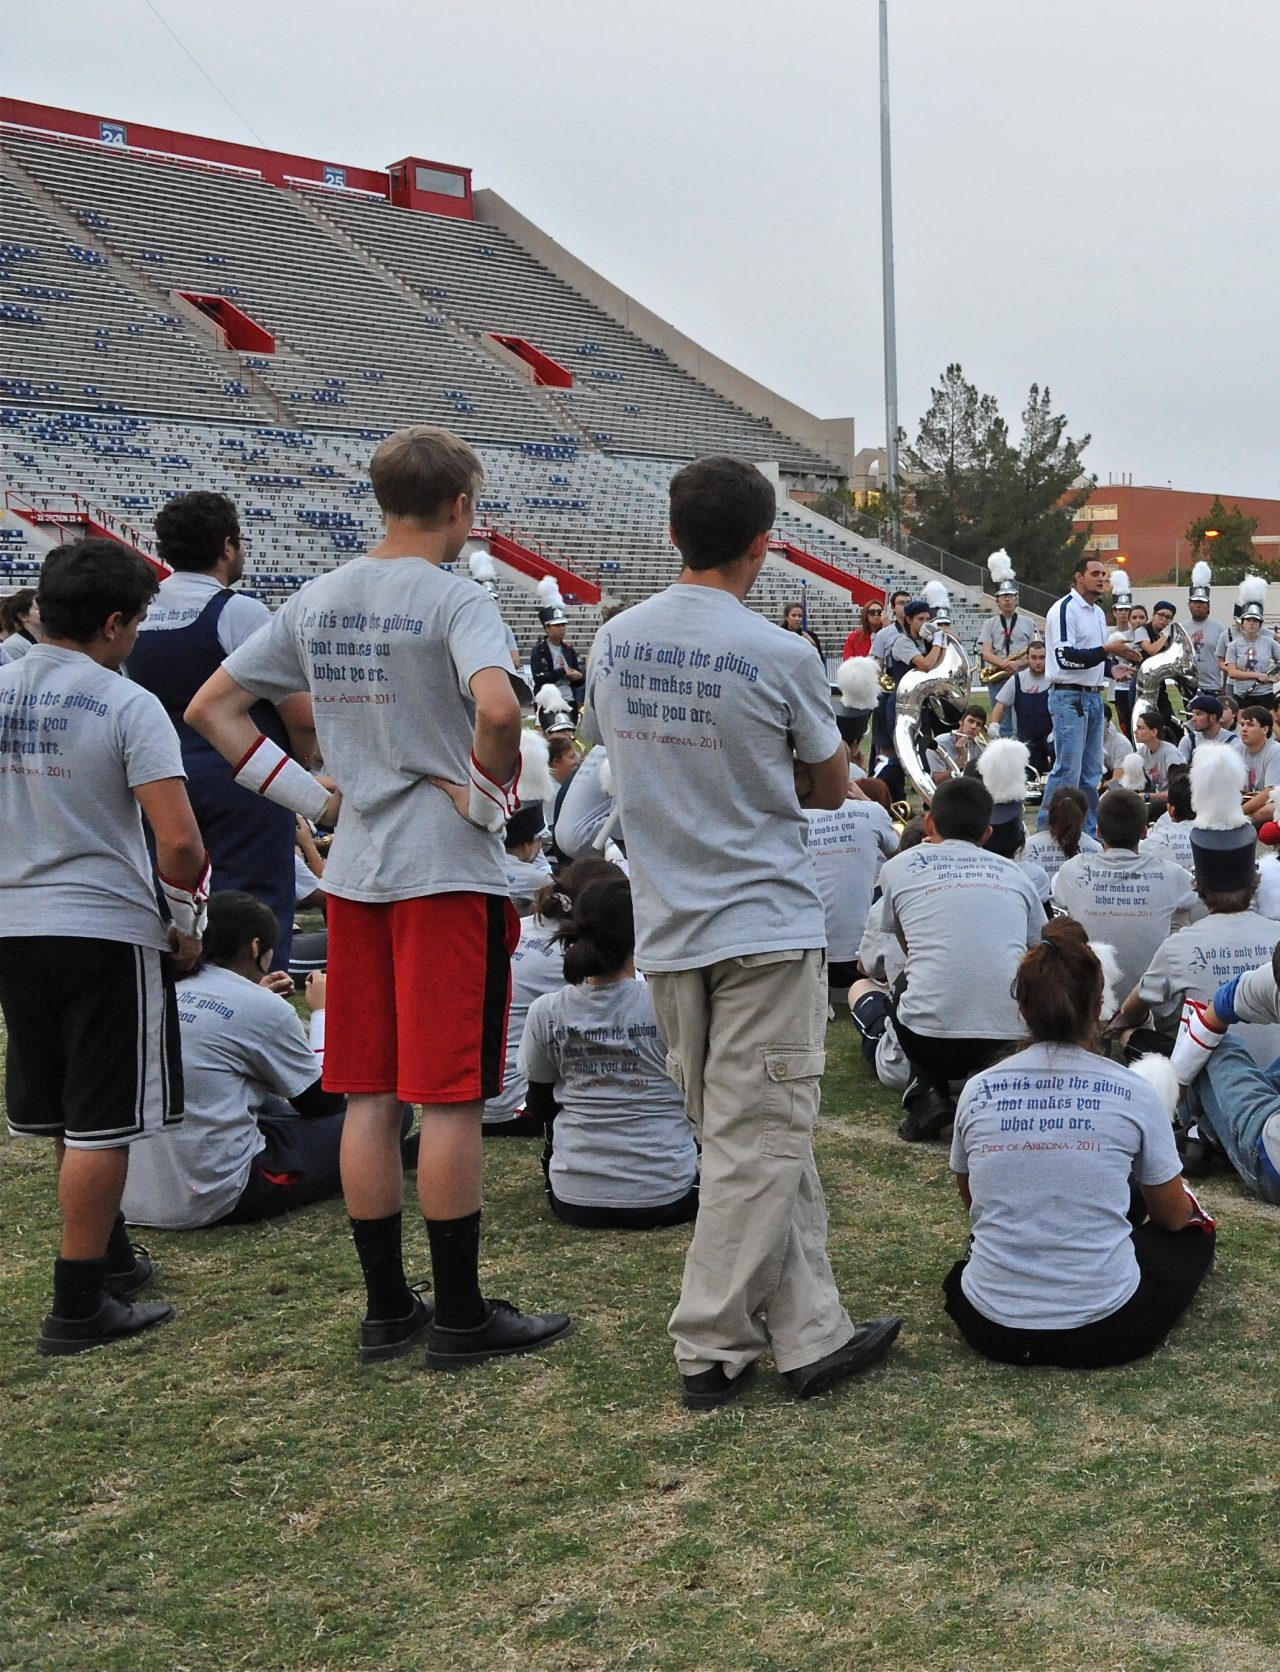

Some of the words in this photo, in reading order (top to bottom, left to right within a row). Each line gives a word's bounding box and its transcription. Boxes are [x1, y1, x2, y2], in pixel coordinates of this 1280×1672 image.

[102, 130, 124, 144] 24
[326, 174, 344, 187] 25
[168, 609, 180, 620] the
[318, 611, 337, 628] it's
[342, 613, 367, 632] only
[382, 613, 423, 634] giving
[308, 638, 332, 657] that
[598, 633, 630, 672] And
[633, 640, 652, 661] it's
[656, 646, 685, 668] only
[689, 648, 711, 669] the
[714, 651, 759, 682] giving
[313, 662, 346, 682] what
[619, 670, 645, 690] that
[649, 675, 693, 696] makes
[697, 681, 722, 699] you
[40, 692, 61, 706] the
[62, 692, 108, 717] giving
[627, 696, 658, 718] what
[662, 702, 686, 723] you
[690, 708, 716, 726] are.
[44, 717, 68, 732] you
[636, 731, 649, 740] OF
[699, 736, 723, 750] 2011
[47, 766, 72, 779] 2011
[817, 814, 832, 824] only
[834, 811, 846, 821] the
[814, 825, 839, 835] makes
[842, 822, 856, 832] you
[823, 837, 837, 847] you
[1095, 895, 1115, 905] what
[1116, 897, 1131, 907] you
[1188, 947, 1216, 971] And
[1219, 947, 1232, 959] it's
[1234, 948, 1253, 960] only
[1255, 944, 1268, 956] the
[1212, 965, 1230, 976] that
[195, 998, 234, 1021] giving
[600, 1061, 618, 1075] you
[969, 1078, 1008, 1109] And
[1012, 1077, 1030, 1091] it's
[1035, 1076, 1064, 1092] only
[1069, 1076, 1089, 1090] the
[1092, 1079, 1132, 1101] giving
[997, 1097, 1022, 1112] that
[1027, 1096, 1071, 1111] makes
[1076, 1097, 1100, 1111] you
[1001, 1116, 1034, 1133] what
[1039, 1117, 1069, 1133] you
[1069, 1117, 1096, 1131] are.
[982, 1144, 1004, 1153] PRIDE
[1006, 1143, 1019, 1152] OF
[1076, 1141, 1100, 1153] 2011
